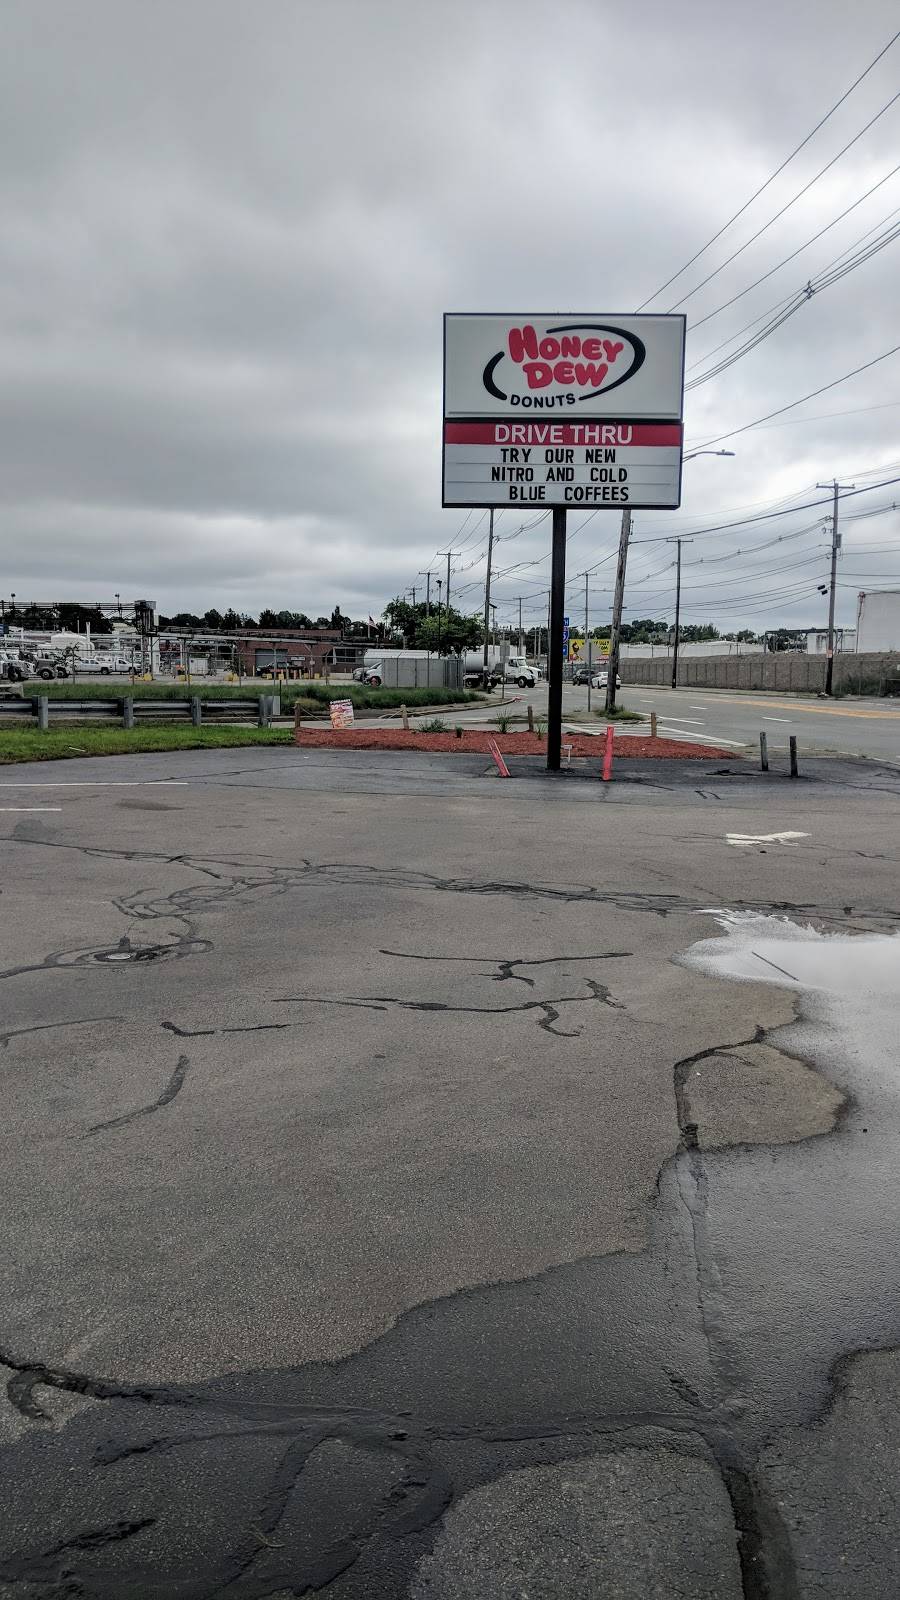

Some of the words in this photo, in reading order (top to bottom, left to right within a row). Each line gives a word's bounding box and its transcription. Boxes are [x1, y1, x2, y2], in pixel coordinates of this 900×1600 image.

[508, 325, 624, 363] HONEY
[522, 361, 608, 389] DEW
[510, 393, 576, 408] DONUTS
[494, 424, 564, 443] DRIVE
[570, 424, 633, 444] THRU
[500, 448, 531, 463] TRY
[545, 449, 574, 463] OUR
[585, 449, 616, 463] NEW
[491, 467, 534, 481] NITRO
[546, 467, 575, 482] AND
[590, 468, 628, 482] COLD
[509, 486, 546, 500] BLUE
[564, 487, 629, 501] COFFEES
